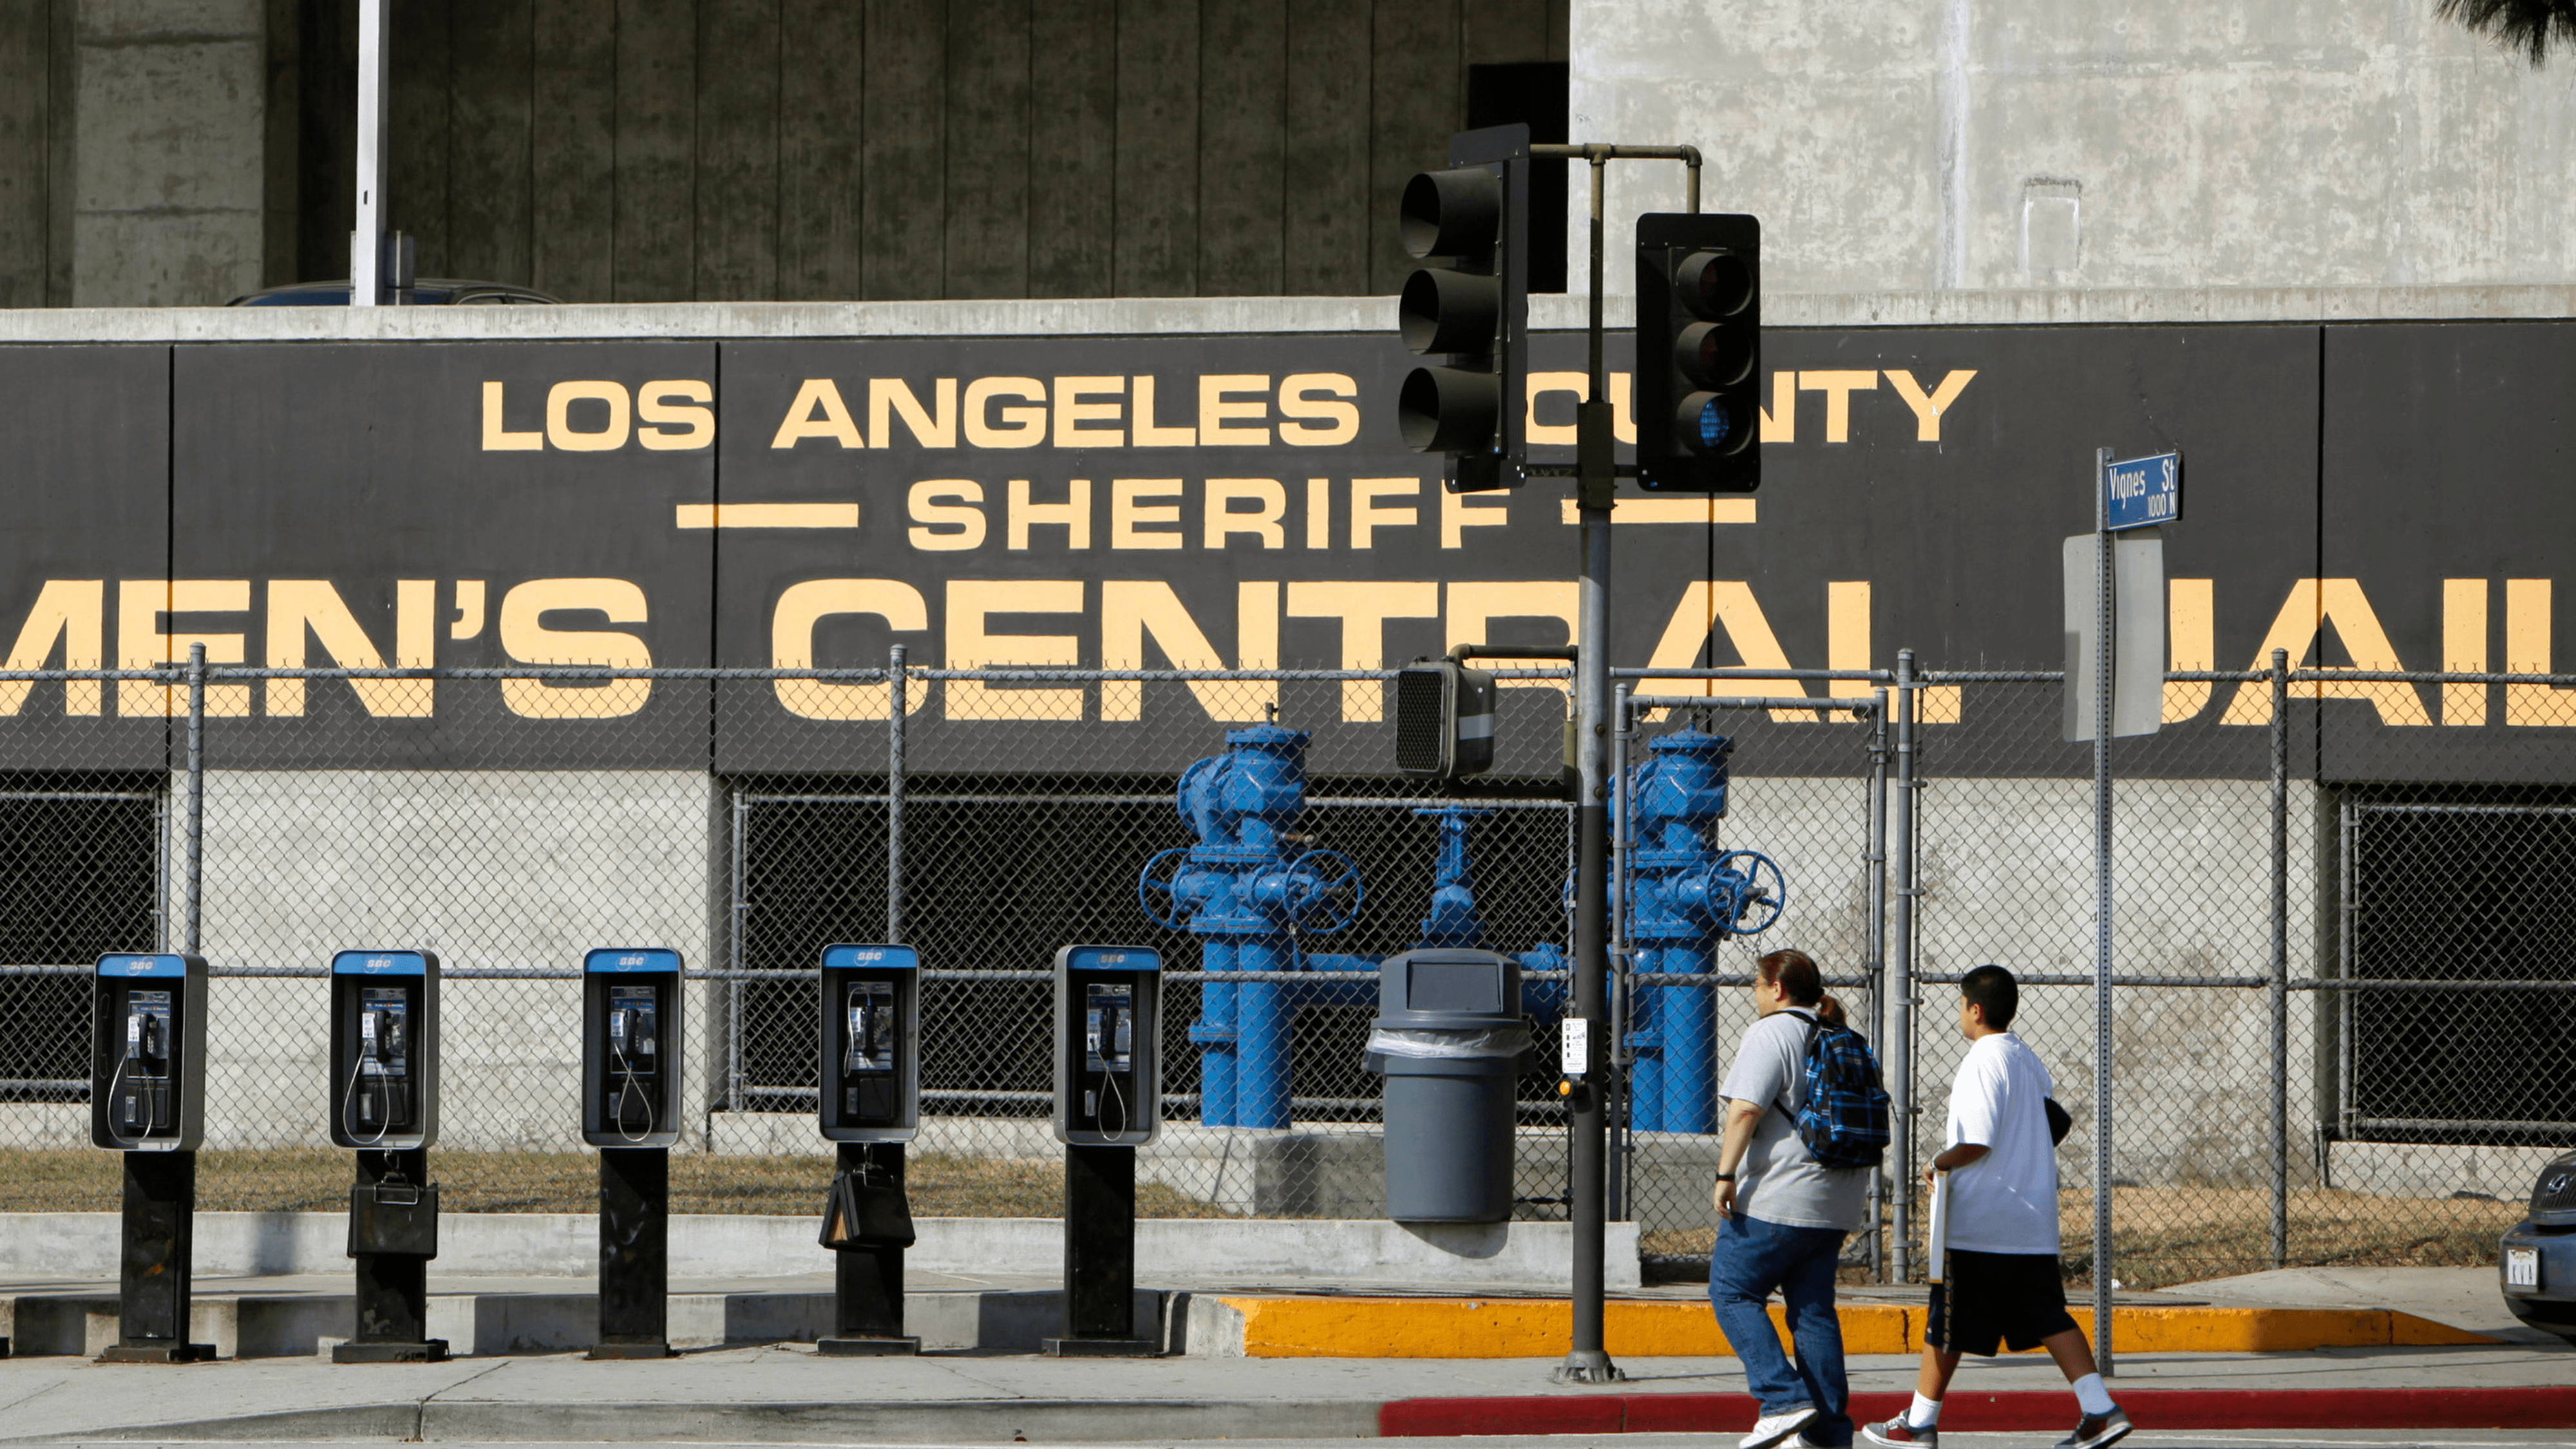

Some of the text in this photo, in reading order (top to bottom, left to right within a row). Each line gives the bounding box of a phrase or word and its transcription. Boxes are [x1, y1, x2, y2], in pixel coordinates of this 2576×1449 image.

[483, 370, 1978, 451] LOS ANGELES OTY
[907, 478, 1510, 551] SHERIFF
[2109, 459, 2175, 509] Vignes St
[2148, 492, 2176, 518] 1000 N
[772, 578, 1962, 724] CENTRAL
